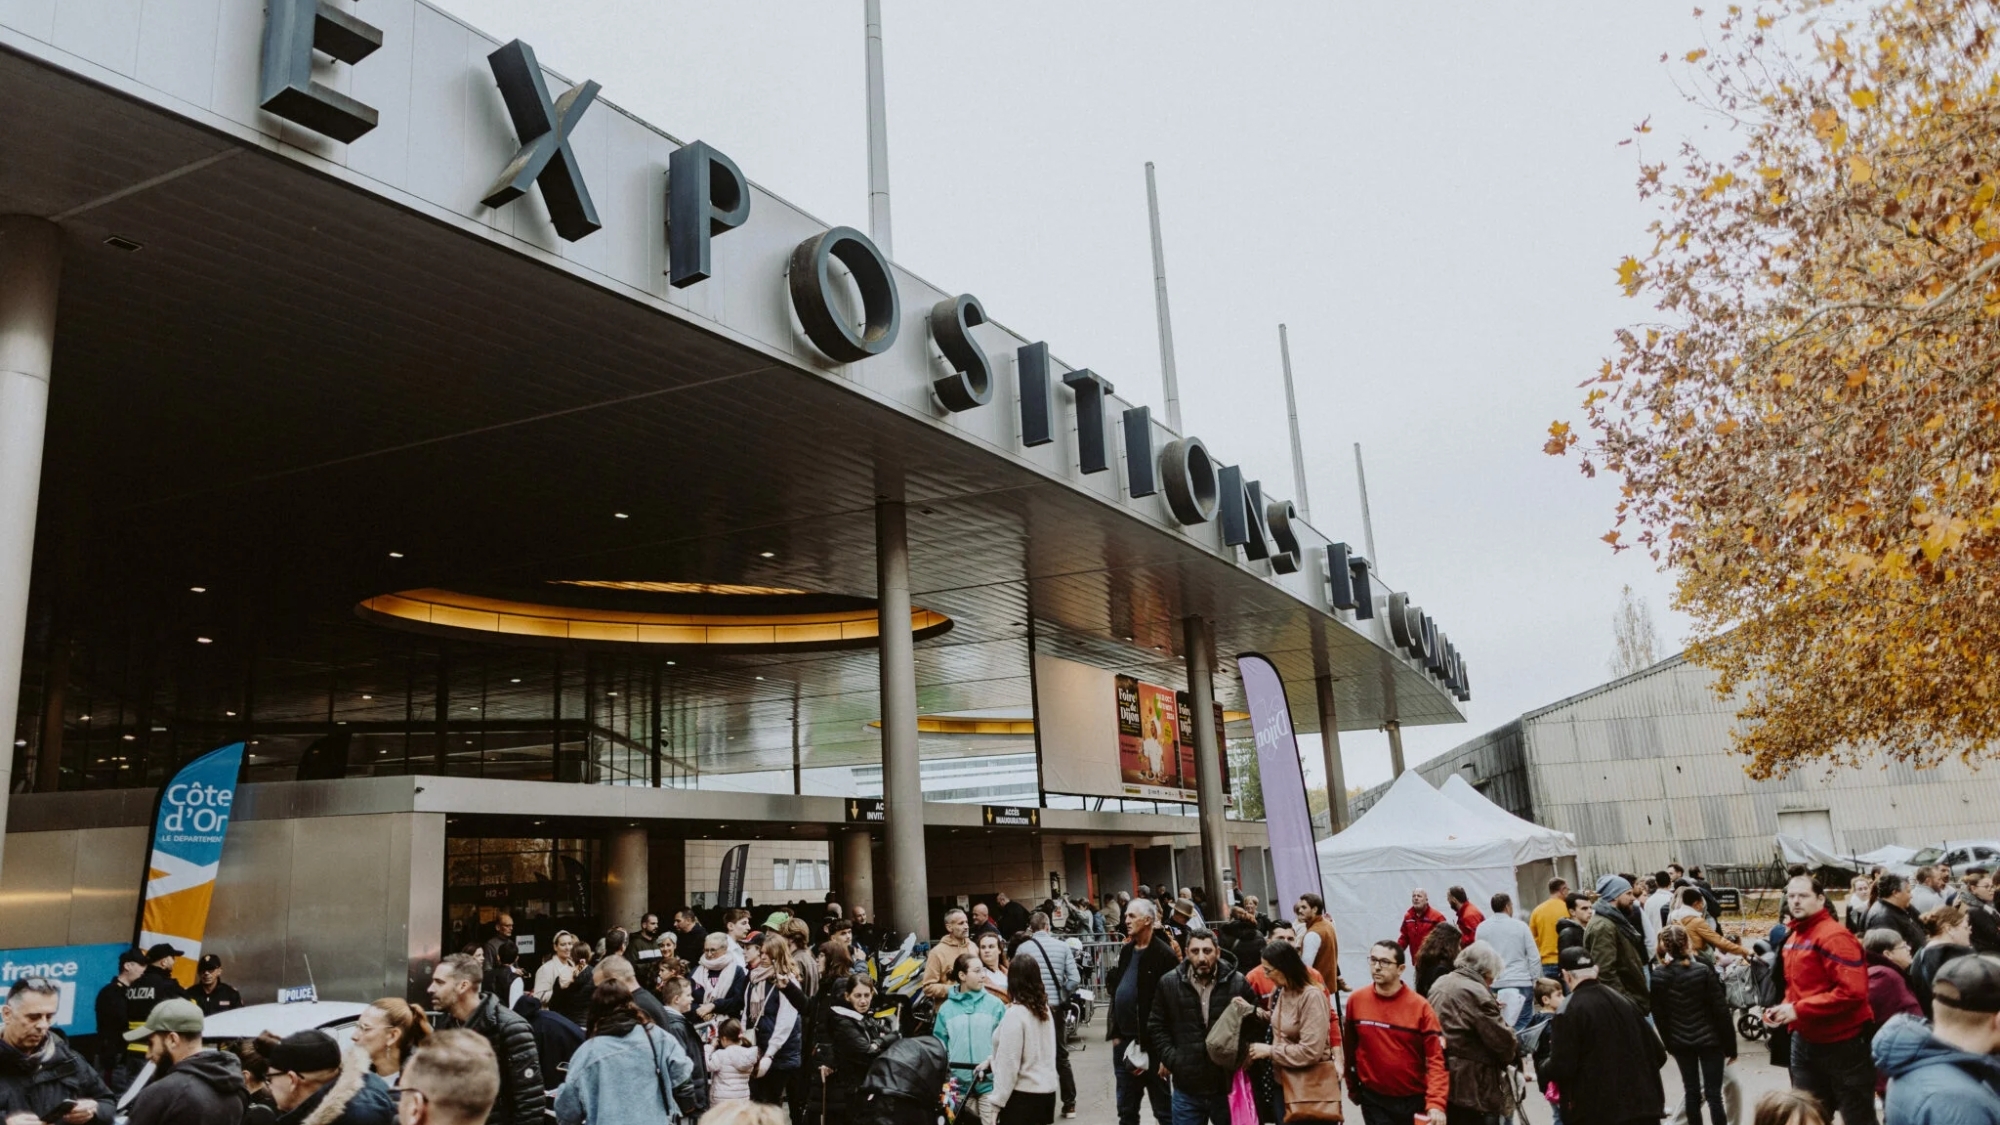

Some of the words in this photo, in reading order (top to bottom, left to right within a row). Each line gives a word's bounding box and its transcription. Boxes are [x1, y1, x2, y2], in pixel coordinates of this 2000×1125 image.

[260, 0, 1303, 574] EXPOSITIONS
[1326, 542, 1374, 621] ET
[1118, 687, 1136, 703] Foire
[1120, 706, 1140, 725] Dijon
[167, 781, 232, 807] Côte
[164, 805, 228, 832] d'Or
[995, 815, 1029, 826] INAUGURATION
[1004, 807, 1020, 817] ACCÈS
[2, 960, 79, 982] france
[285, 986, 314, 1003] POLICE
